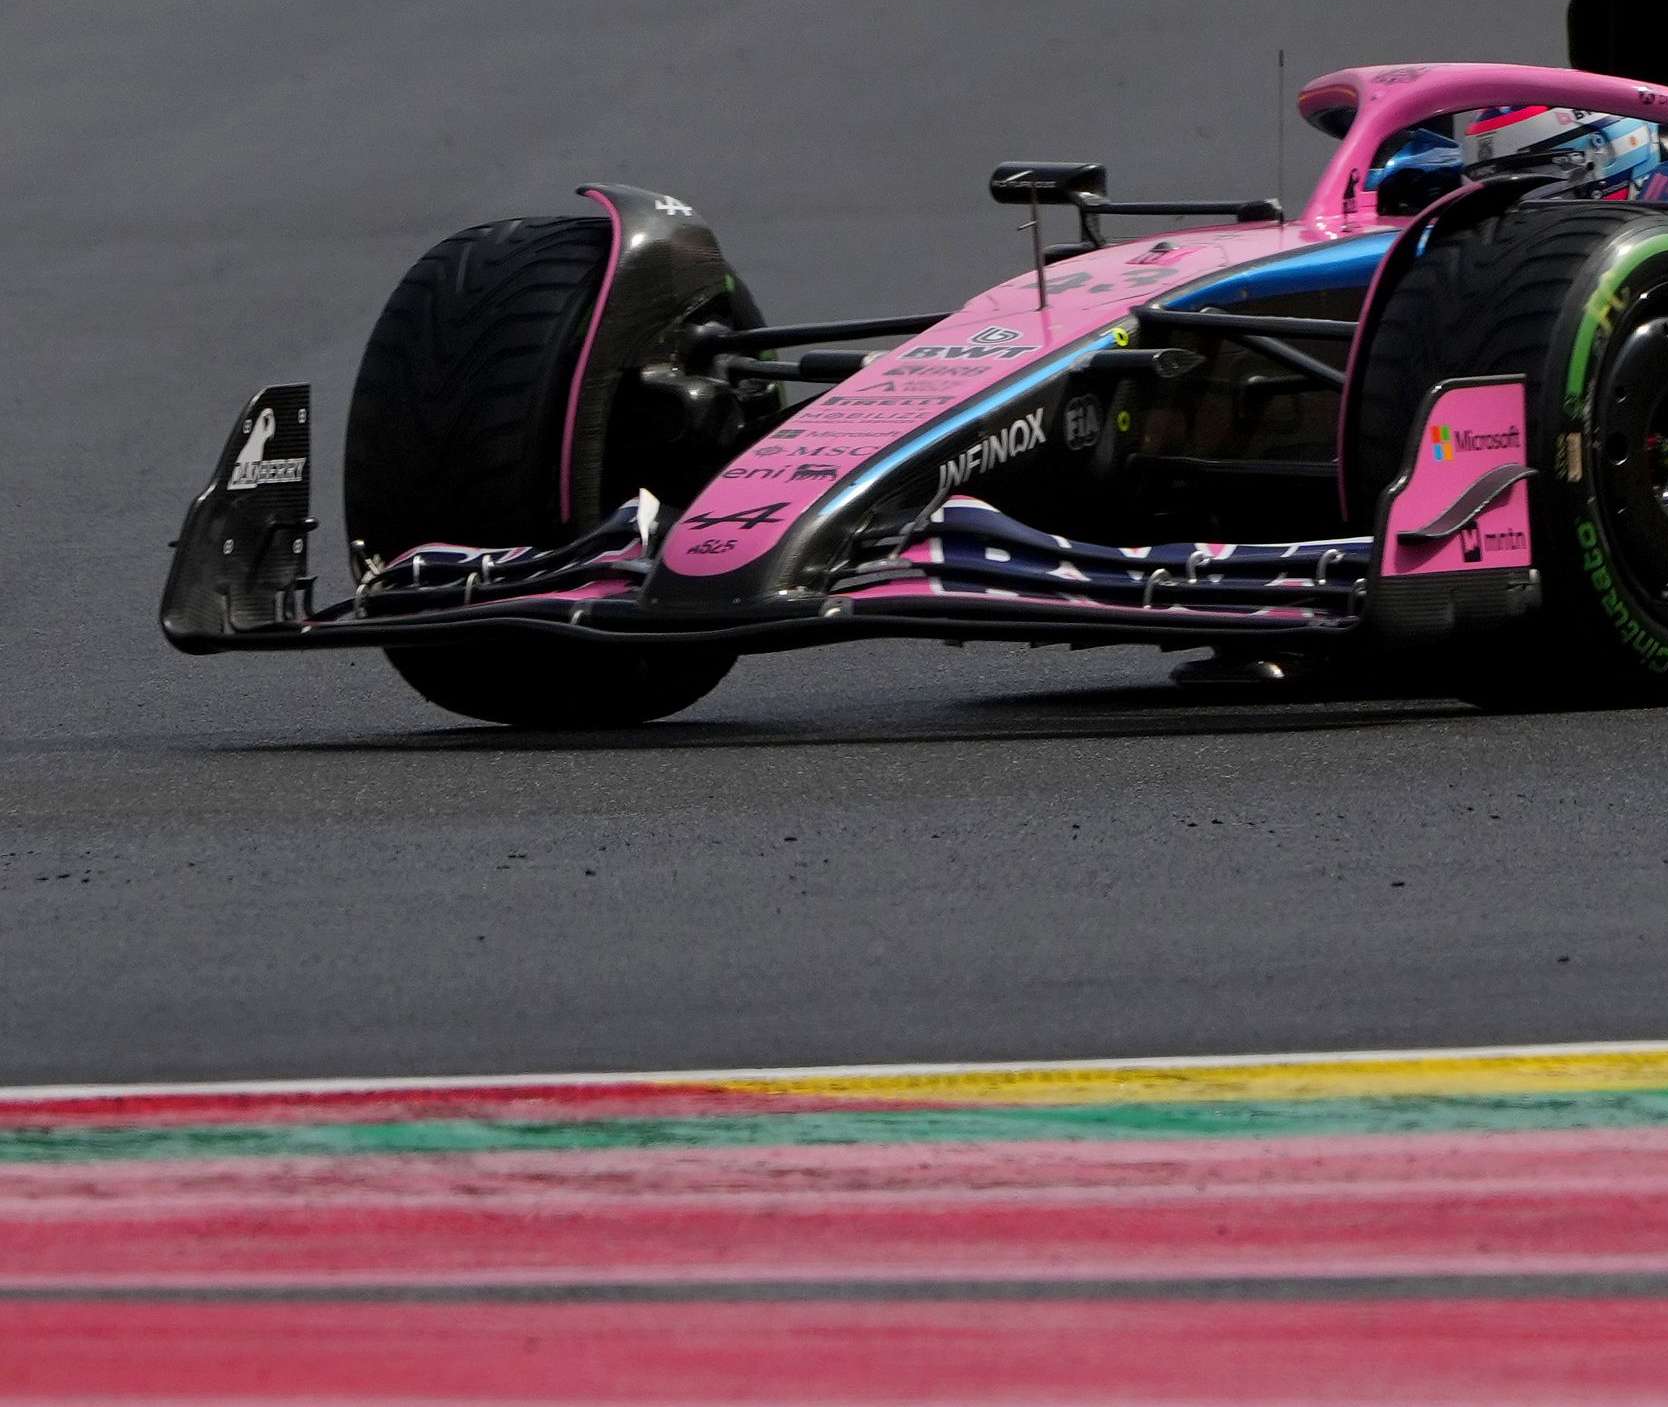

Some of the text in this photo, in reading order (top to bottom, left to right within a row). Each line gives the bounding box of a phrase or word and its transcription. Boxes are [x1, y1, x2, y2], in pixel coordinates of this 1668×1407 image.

[900, 346, 1043, 360] BWT
[939, 407, 1047, 487] INFINOX
[1454, 425, 1521, 453] Microsoft
[785, 445, 880, 457] MSC
[721, 464, 793, 480] eni
